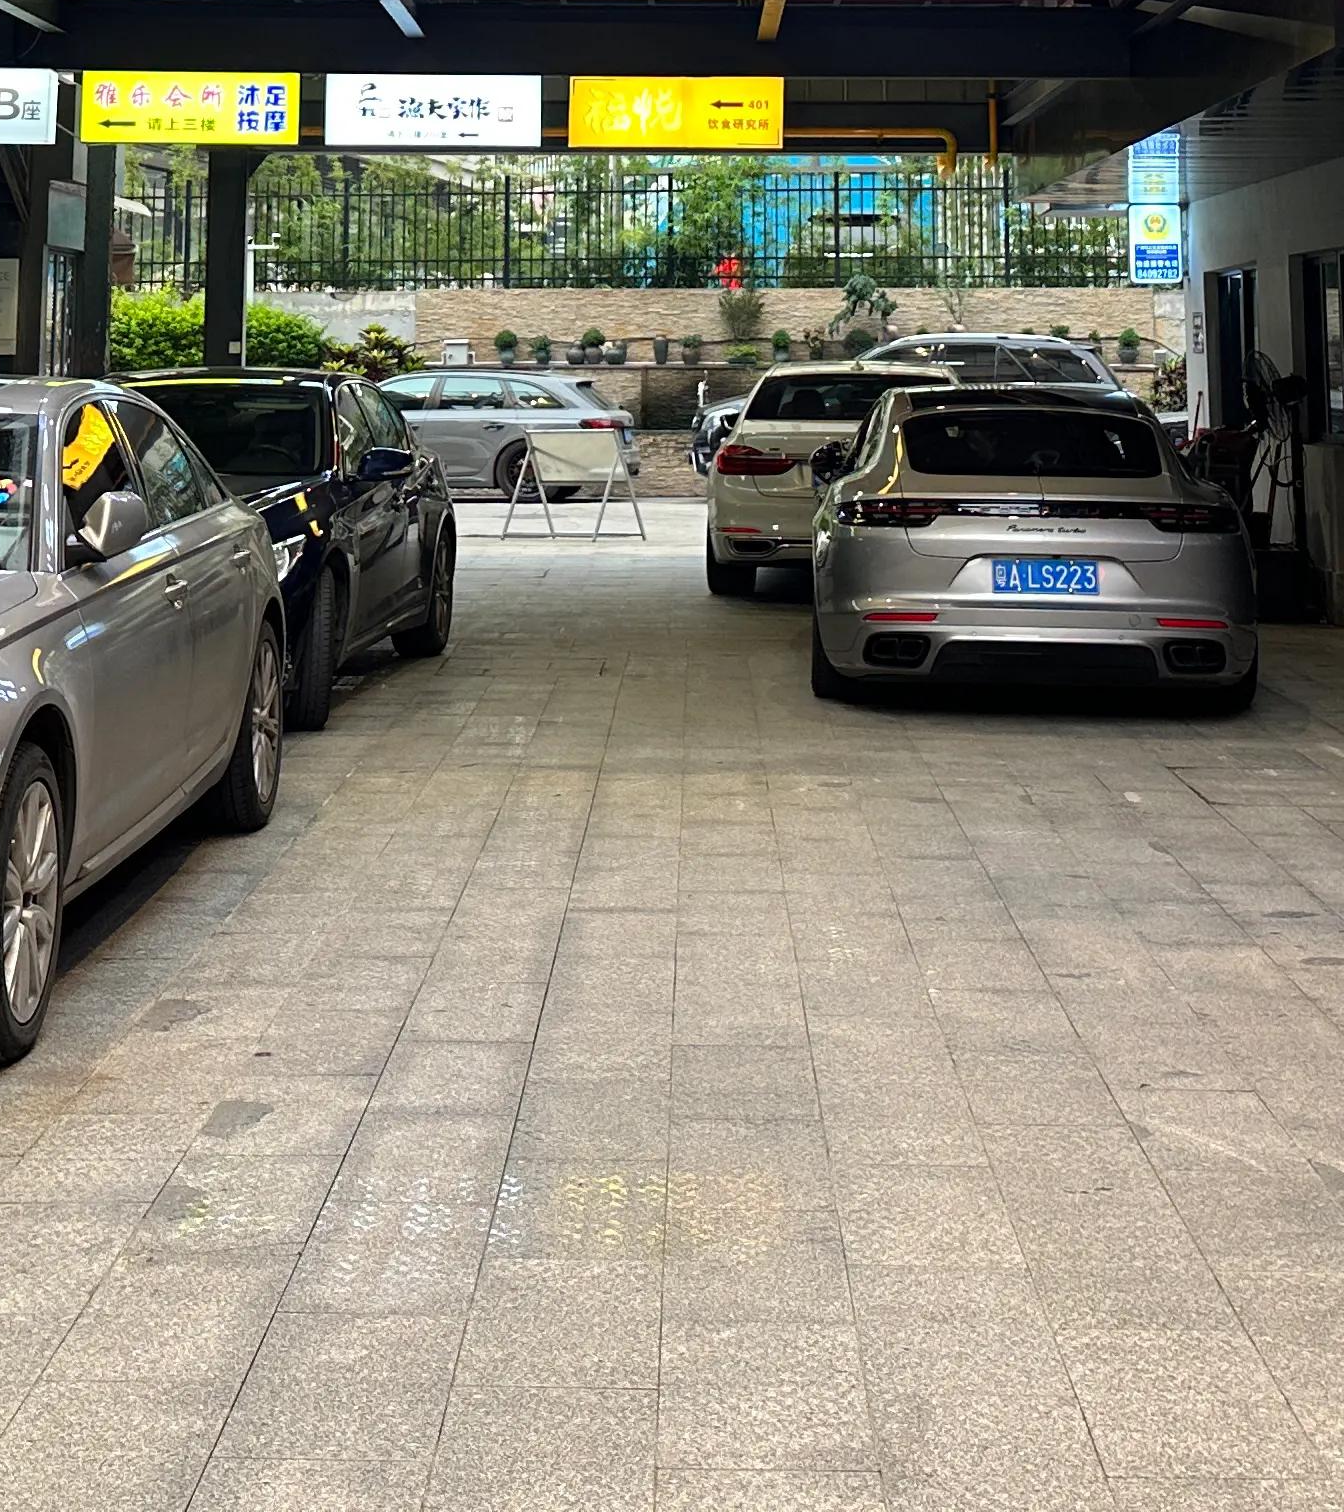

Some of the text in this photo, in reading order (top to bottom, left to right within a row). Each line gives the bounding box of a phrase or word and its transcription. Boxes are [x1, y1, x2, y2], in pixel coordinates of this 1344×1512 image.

[238, 84, 287, 107] 沐足
[748, 100, 769, 110] 401
[147, 117, 216, 132] 请上三楼
[237, 110, 287, 132] 按摩
[707, 118, 769, 131] 饮食研究所
